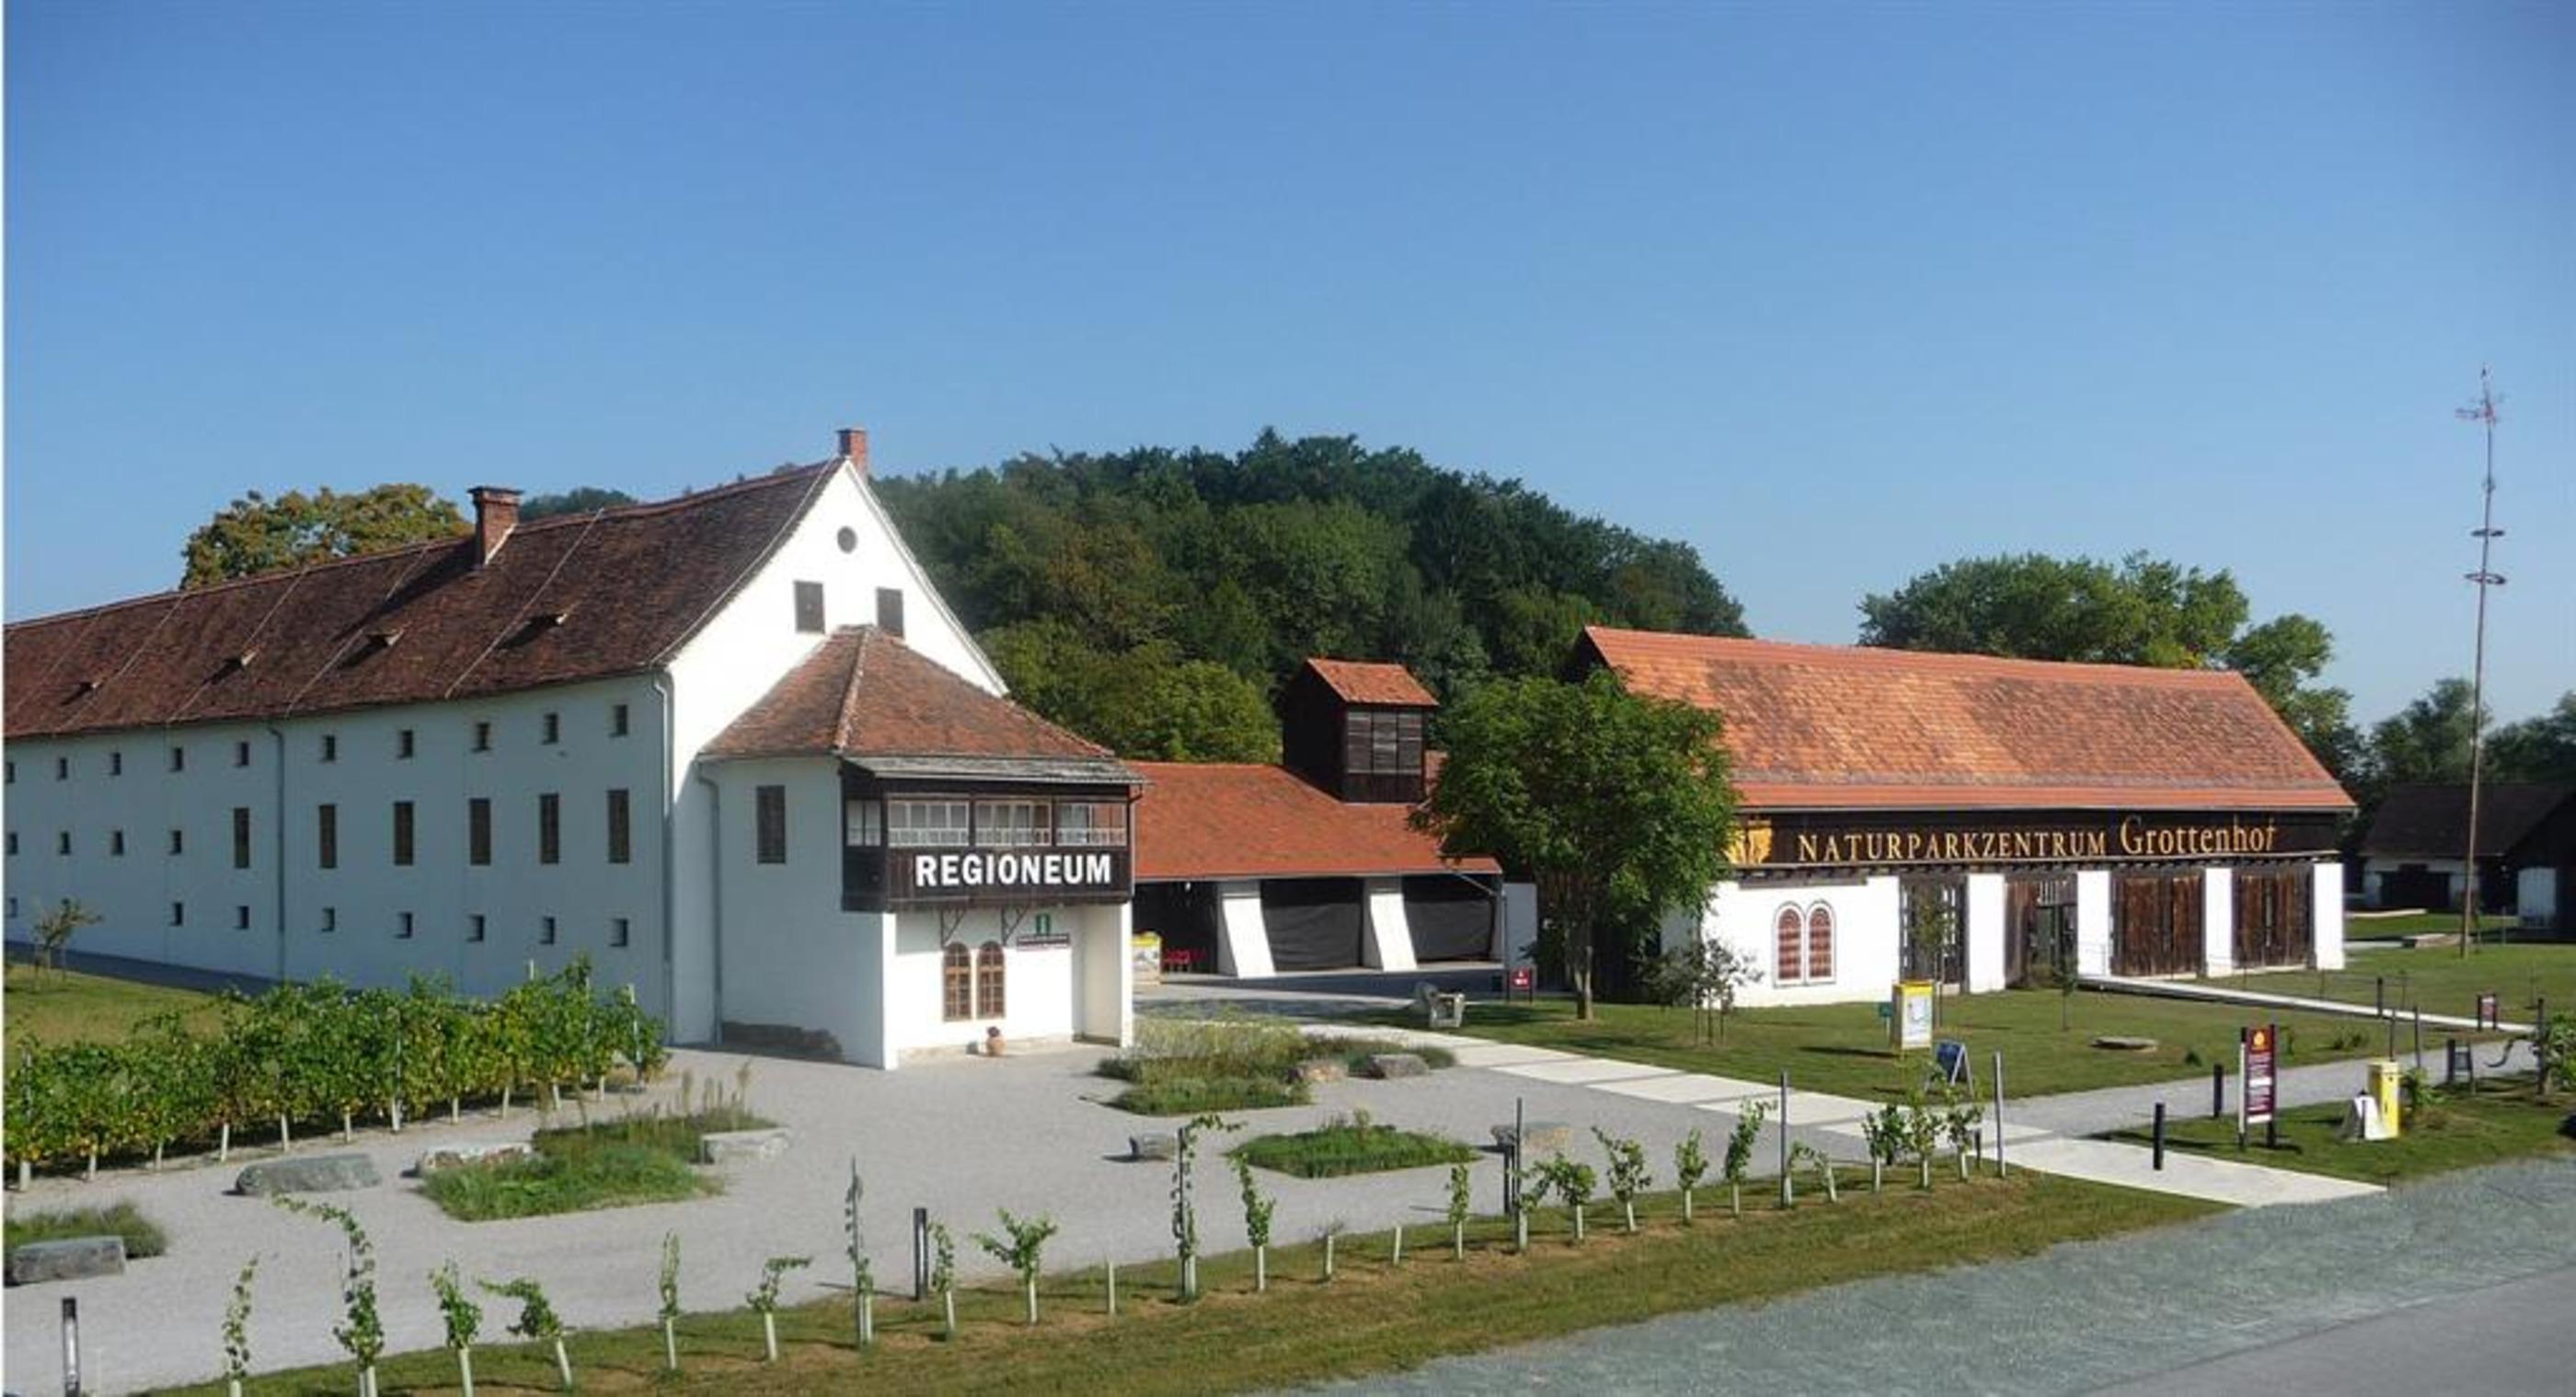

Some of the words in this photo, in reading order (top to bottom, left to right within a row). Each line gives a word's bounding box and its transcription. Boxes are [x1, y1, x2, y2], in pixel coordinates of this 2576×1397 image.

[1798, 831, 2106, 862] NATURPARKZENTRUM
[2120, 814, 2277, 855] Grottenhof
[914, 853, 1111, 887] REGIONEUM
